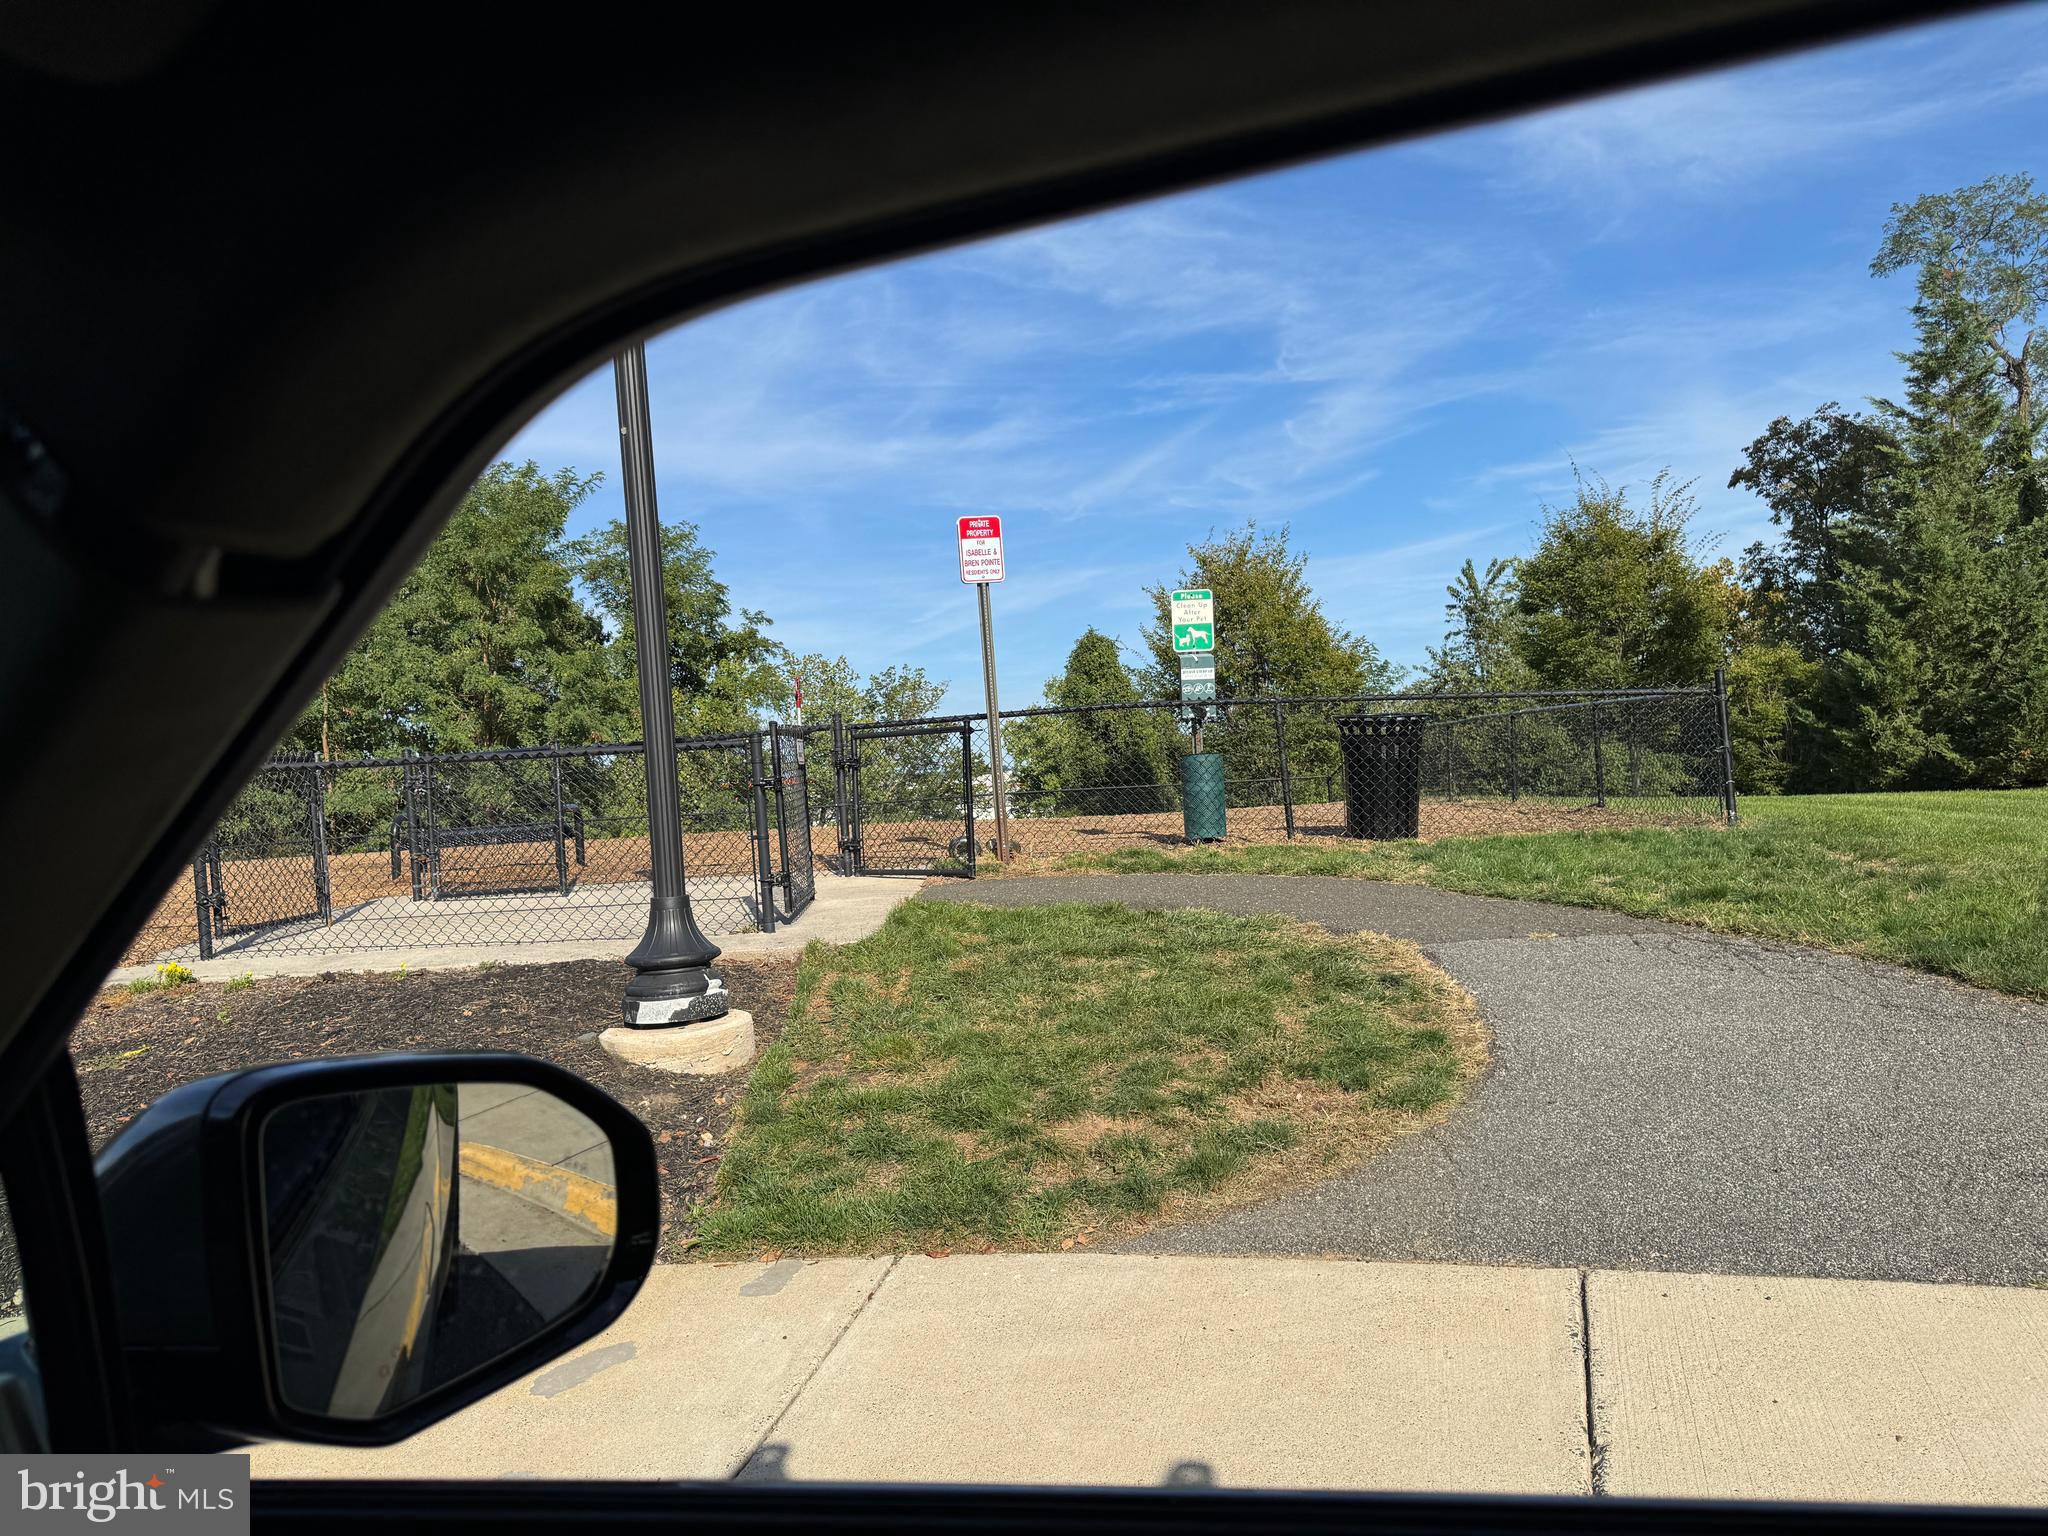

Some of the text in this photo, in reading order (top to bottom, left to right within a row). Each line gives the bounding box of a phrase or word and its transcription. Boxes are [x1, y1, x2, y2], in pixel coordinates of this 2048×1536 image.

[969, 519, 990, 528] PRIVATE
[966, 529, 994, 537] PROPERTY
[966, 549, 991, 557] ISABELLE
[981, 558, 1000, 566] POINTE
